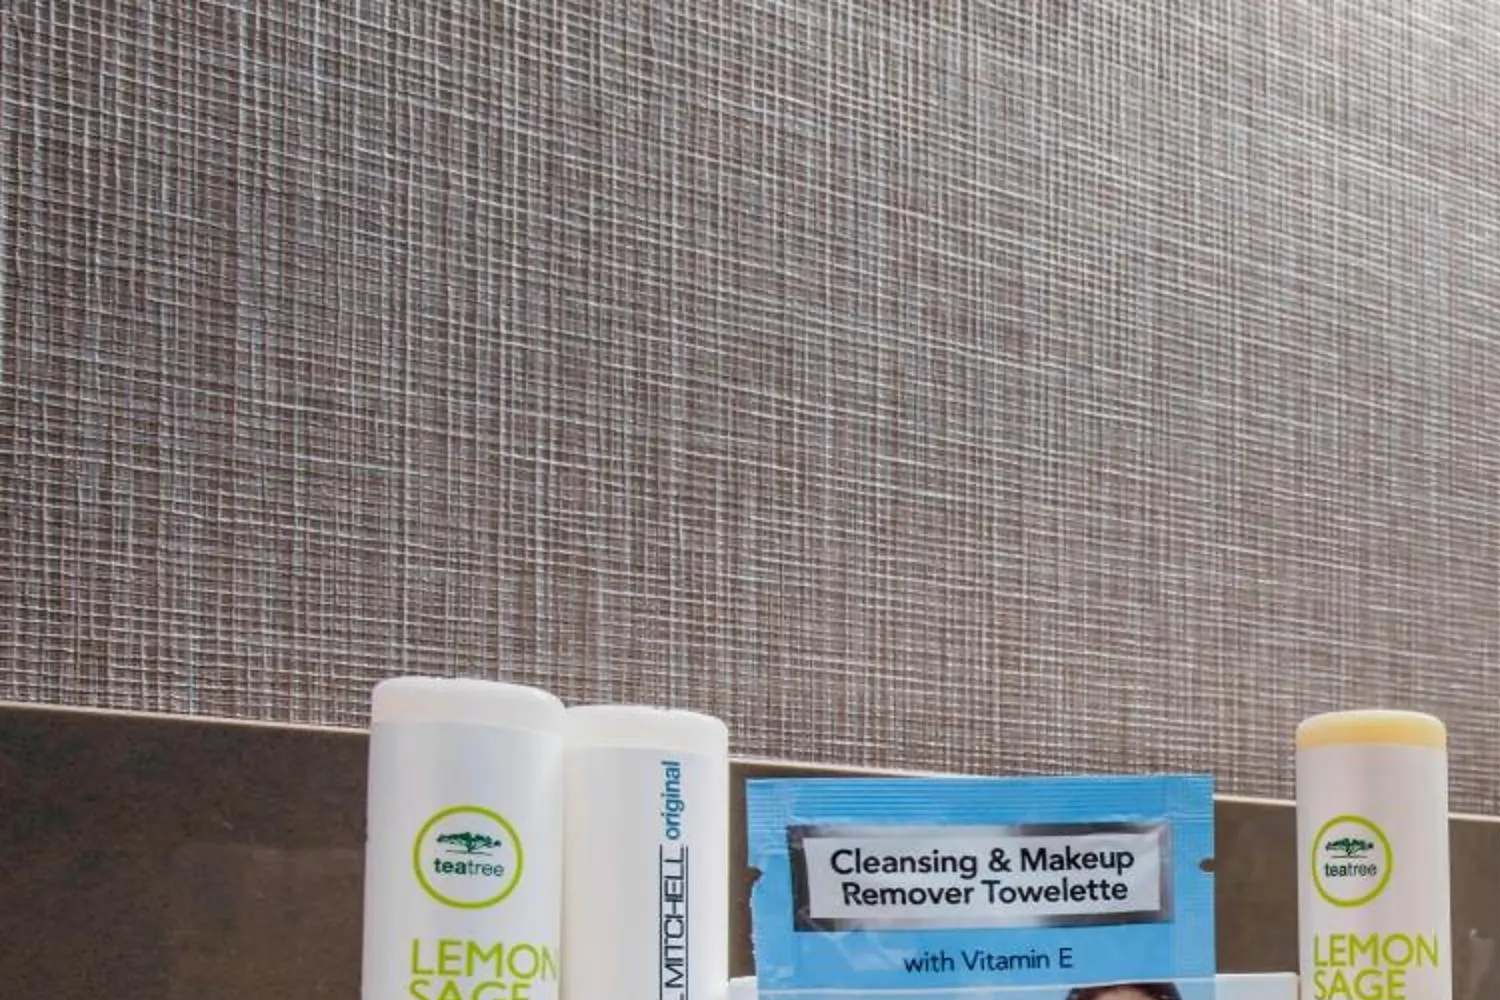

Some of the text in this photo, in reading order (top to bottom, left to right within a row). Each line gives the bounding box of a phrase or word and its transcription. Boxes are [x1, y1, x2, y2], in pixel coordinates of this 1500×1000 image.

[660, 761, 685, 841] original
[434, 856, 504, 878] teatree
[830, 846, 1135, 878] Cleansing & Makeup
[1324, 862, 1378, 878] teatree
[842, 878, 1128, 907] Remover Towelette
[663, 845, 685, 989] MITCHELL
[410, 937, 557, 982] LEMON
[904, 948, 1074, 973] with Vitamin E
[1313, 932, 1439, 969] LEMON
